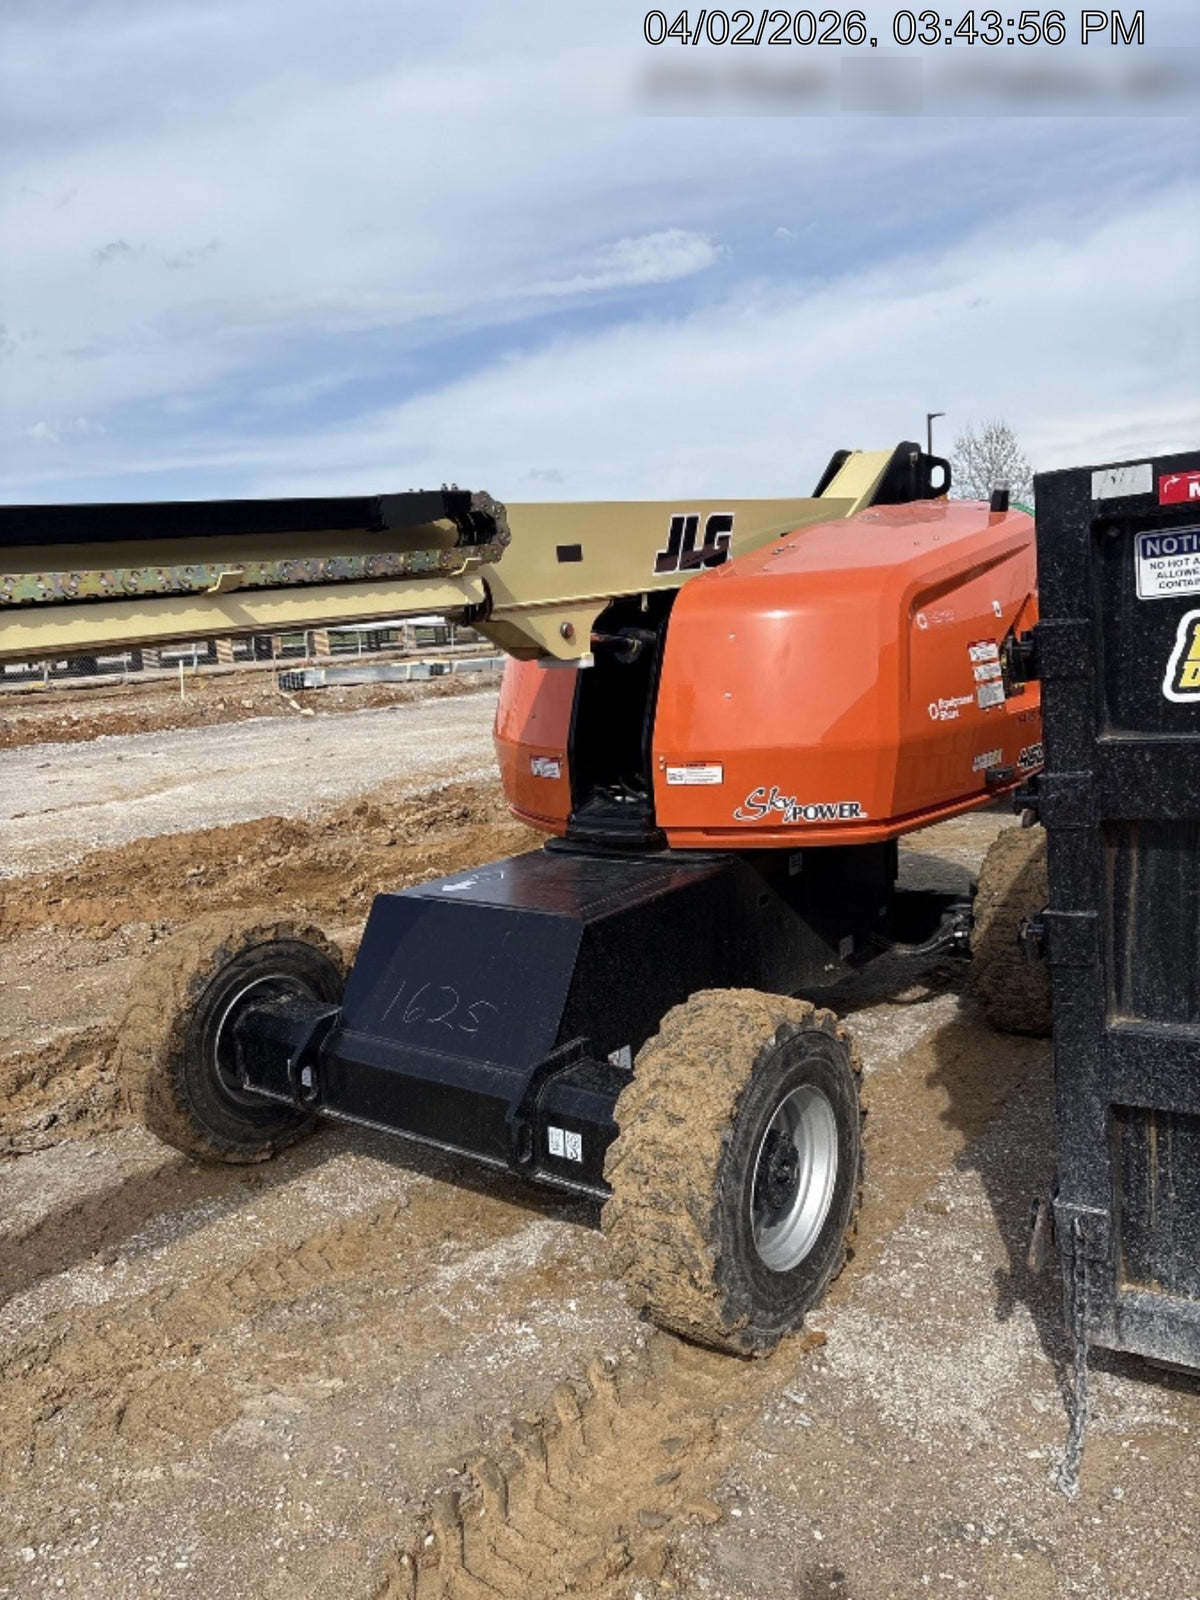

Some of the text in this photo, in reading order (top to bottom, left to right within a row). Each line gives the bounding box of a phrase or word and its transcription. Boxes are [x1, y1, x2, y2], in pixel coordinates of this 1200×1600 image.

[652, 512, 735, 576] JLG
[1146, 534, 1200, 556] NOTI
[1149, 561, 1166, 570] NO
[1167, 557, 1190, 568] HOT
[733, 785, 861, 823] Sky POWER
